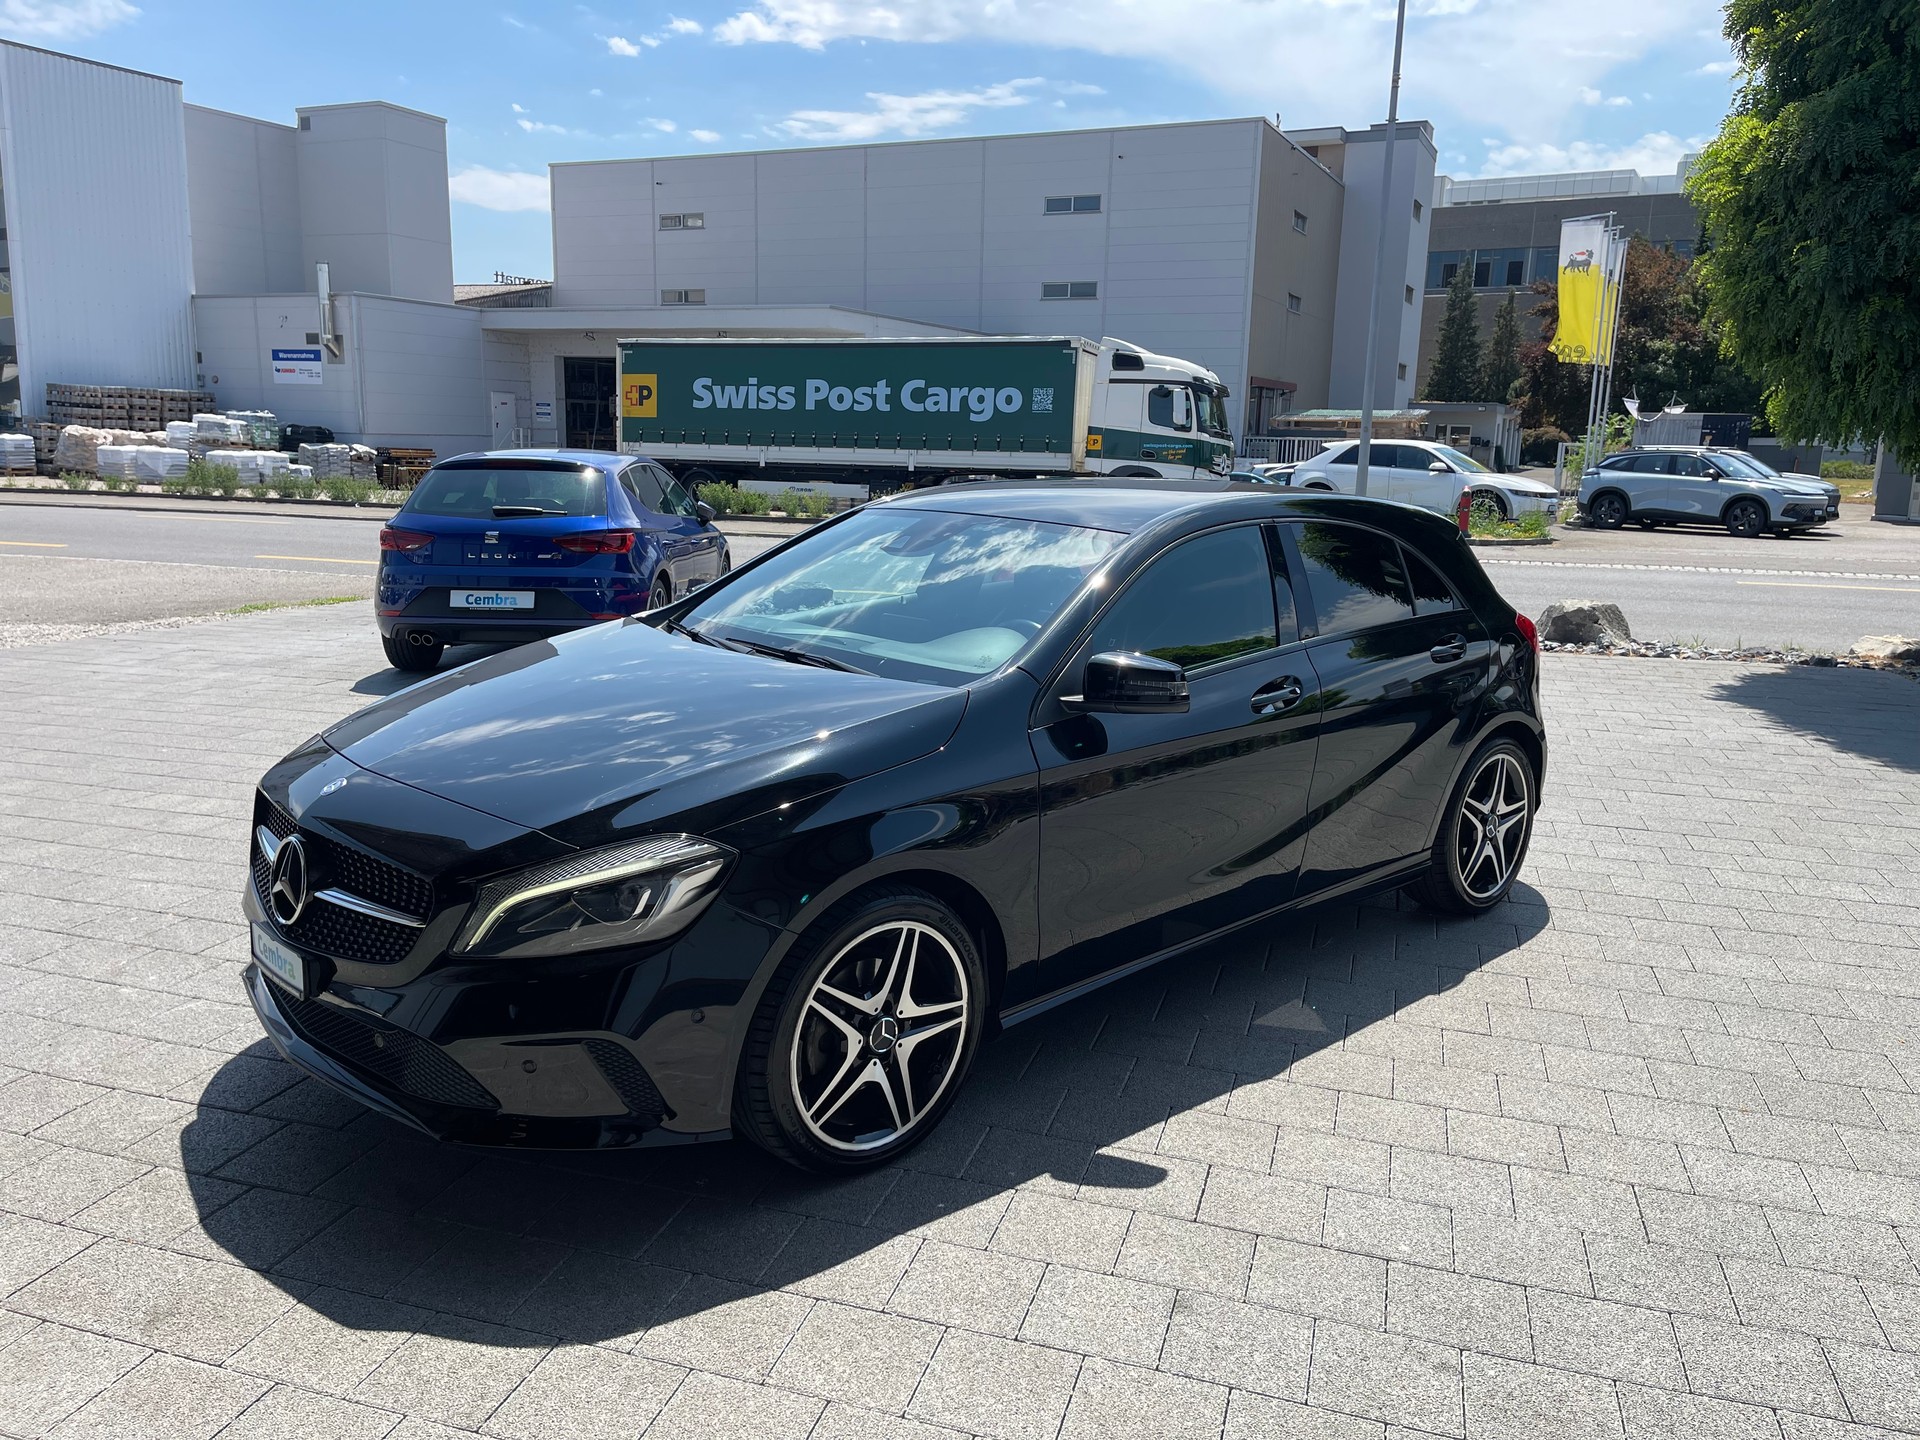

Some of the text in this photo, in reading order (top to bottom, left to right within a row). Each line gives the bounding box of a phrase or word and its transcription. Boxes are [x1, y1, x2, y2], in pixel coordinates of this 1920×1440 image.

[692, 377, 1023, 422] Swiss Post Cargo
[465, 593, 518, 606] Cembra
[257, 934, 296, 980] Cembra
